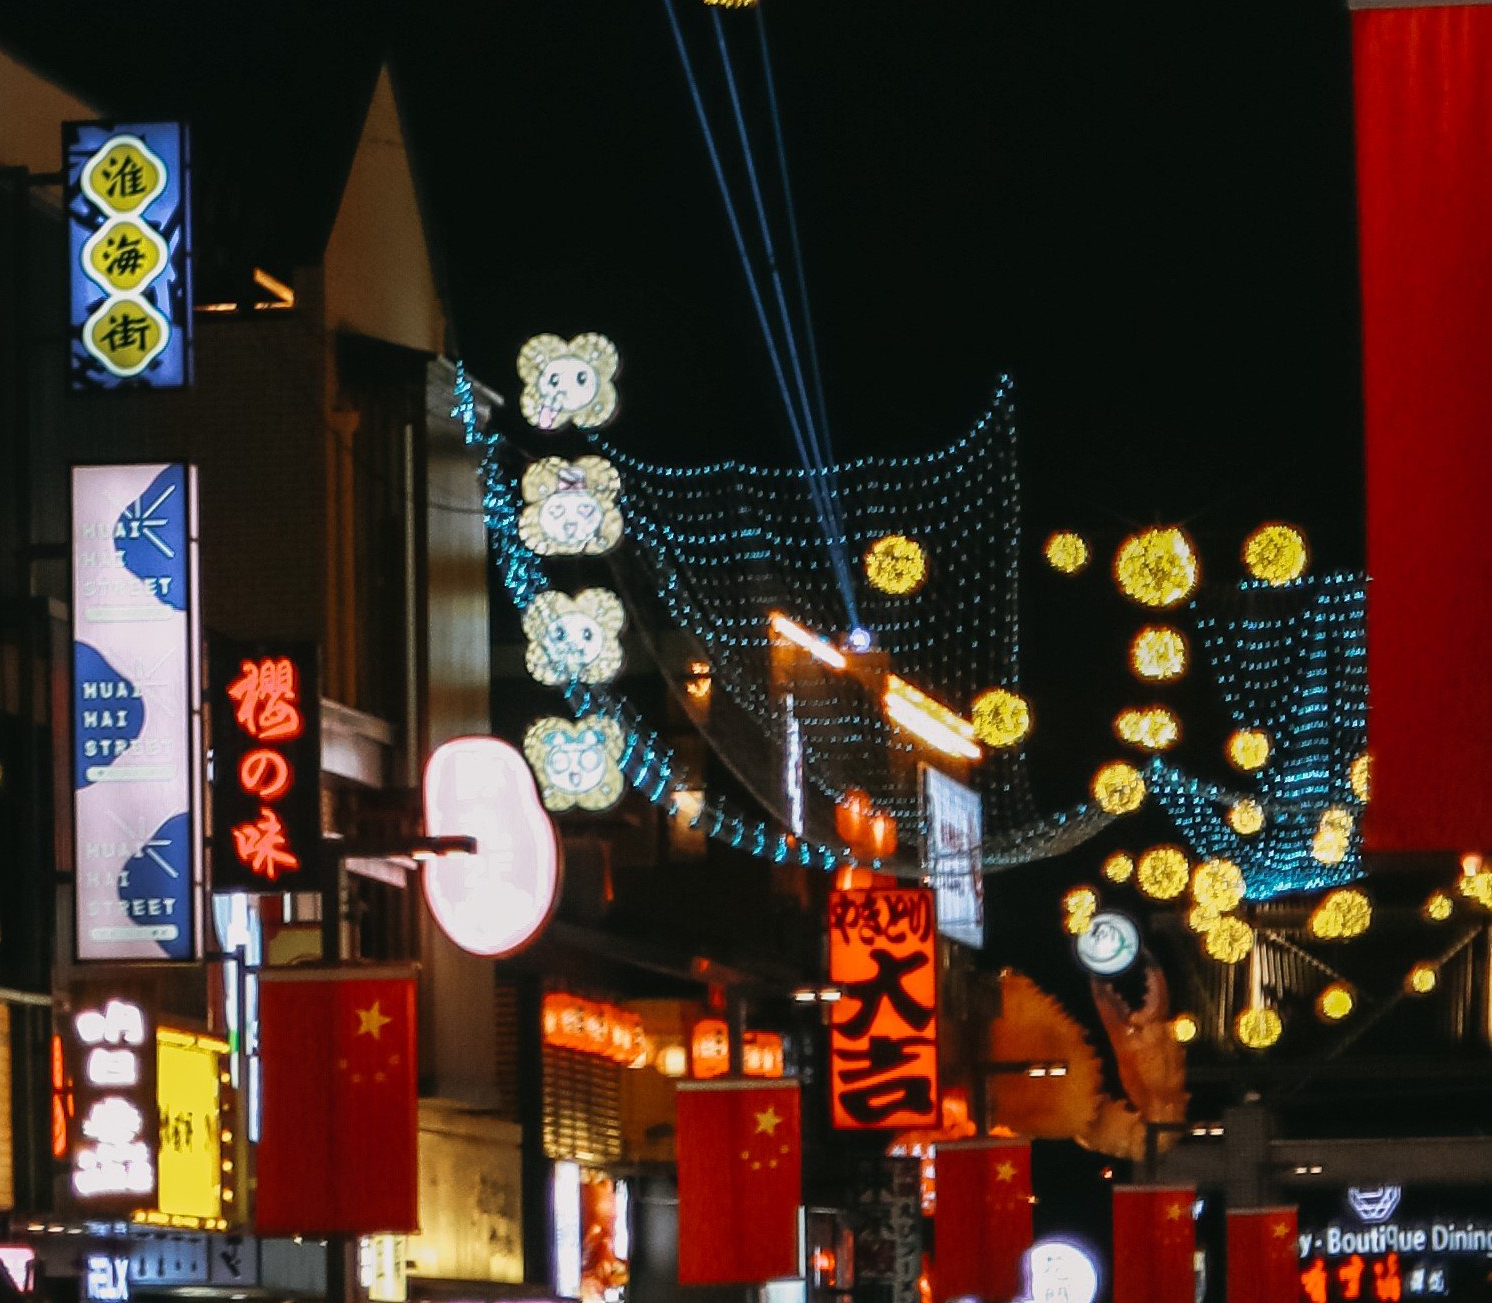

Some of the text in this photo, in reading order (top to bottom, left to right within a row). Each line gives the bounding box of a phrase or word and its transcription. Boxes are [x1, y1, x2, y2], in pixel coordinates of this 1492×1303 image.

[100, 155, 149, 352] 淮海街
[832, 948, 934, 1123] 大吉
